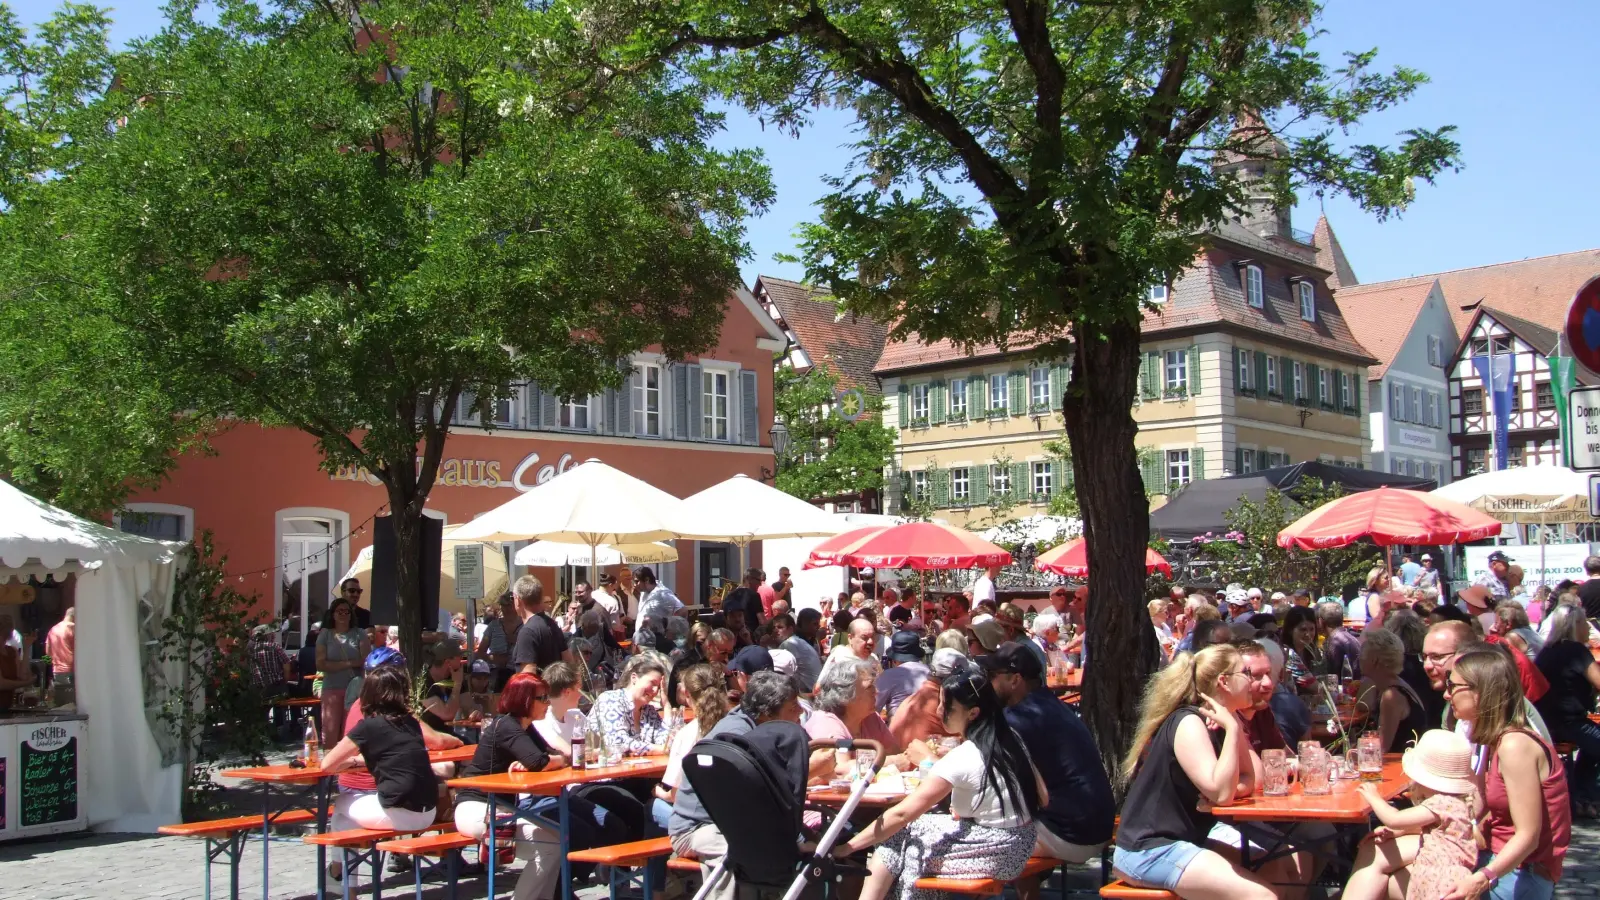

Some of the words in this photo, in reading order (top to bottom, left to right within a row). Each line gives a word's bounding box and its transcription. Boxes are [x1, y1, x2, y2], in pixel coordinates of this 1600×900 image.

[1577, 405, 1600, 417] Donn
[1585, 422, 1598, 434] bis
[1587, 442, 1600, 453] we
[512, 452, 580, 494] Caf
[1492, 498, 1531, 510] FISCHER
[926, 556, 949, 565] Coca-Cola
[1535, 567, 1560, 575] MAXI
[1563, 566, 1583, 574] ZOO
[32, 726, 67, 740] FISCHER
[28, 754, 46, 767] Bier
[25, 766, 53, 779] Radler
